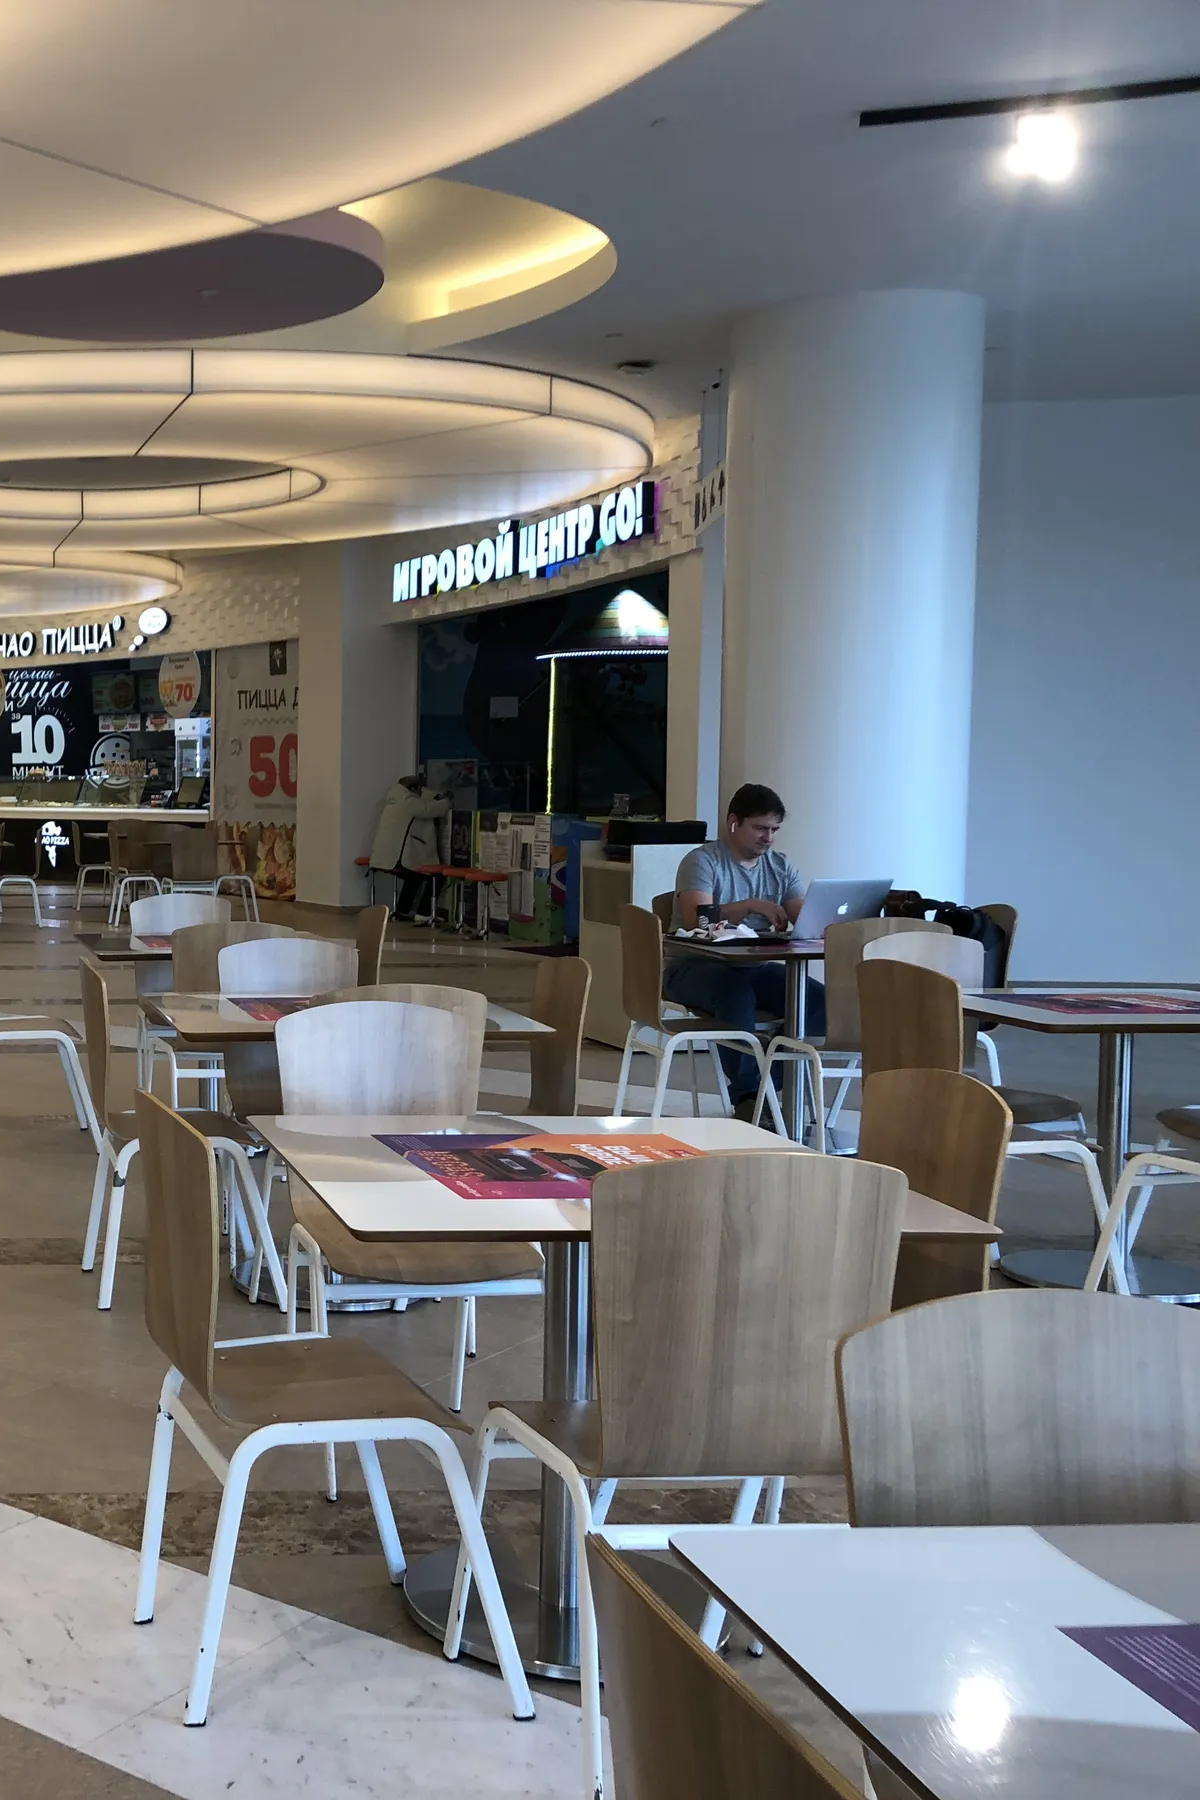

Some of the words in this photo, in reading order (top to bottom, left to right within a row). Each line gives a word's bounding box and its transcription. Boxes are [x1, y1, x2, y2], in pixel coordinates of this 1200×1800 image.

[393, 520, 515, 603] ИГРОВОЙ
[518, 503, 595, 579] ЦЕНТР
[600, 481, 646, 547] GO!
[42, 622, 113, 655] ПИЦЦА
[237, 688, 287, 711] ПИЦЦА
[11, 714, 65, 765] 10
